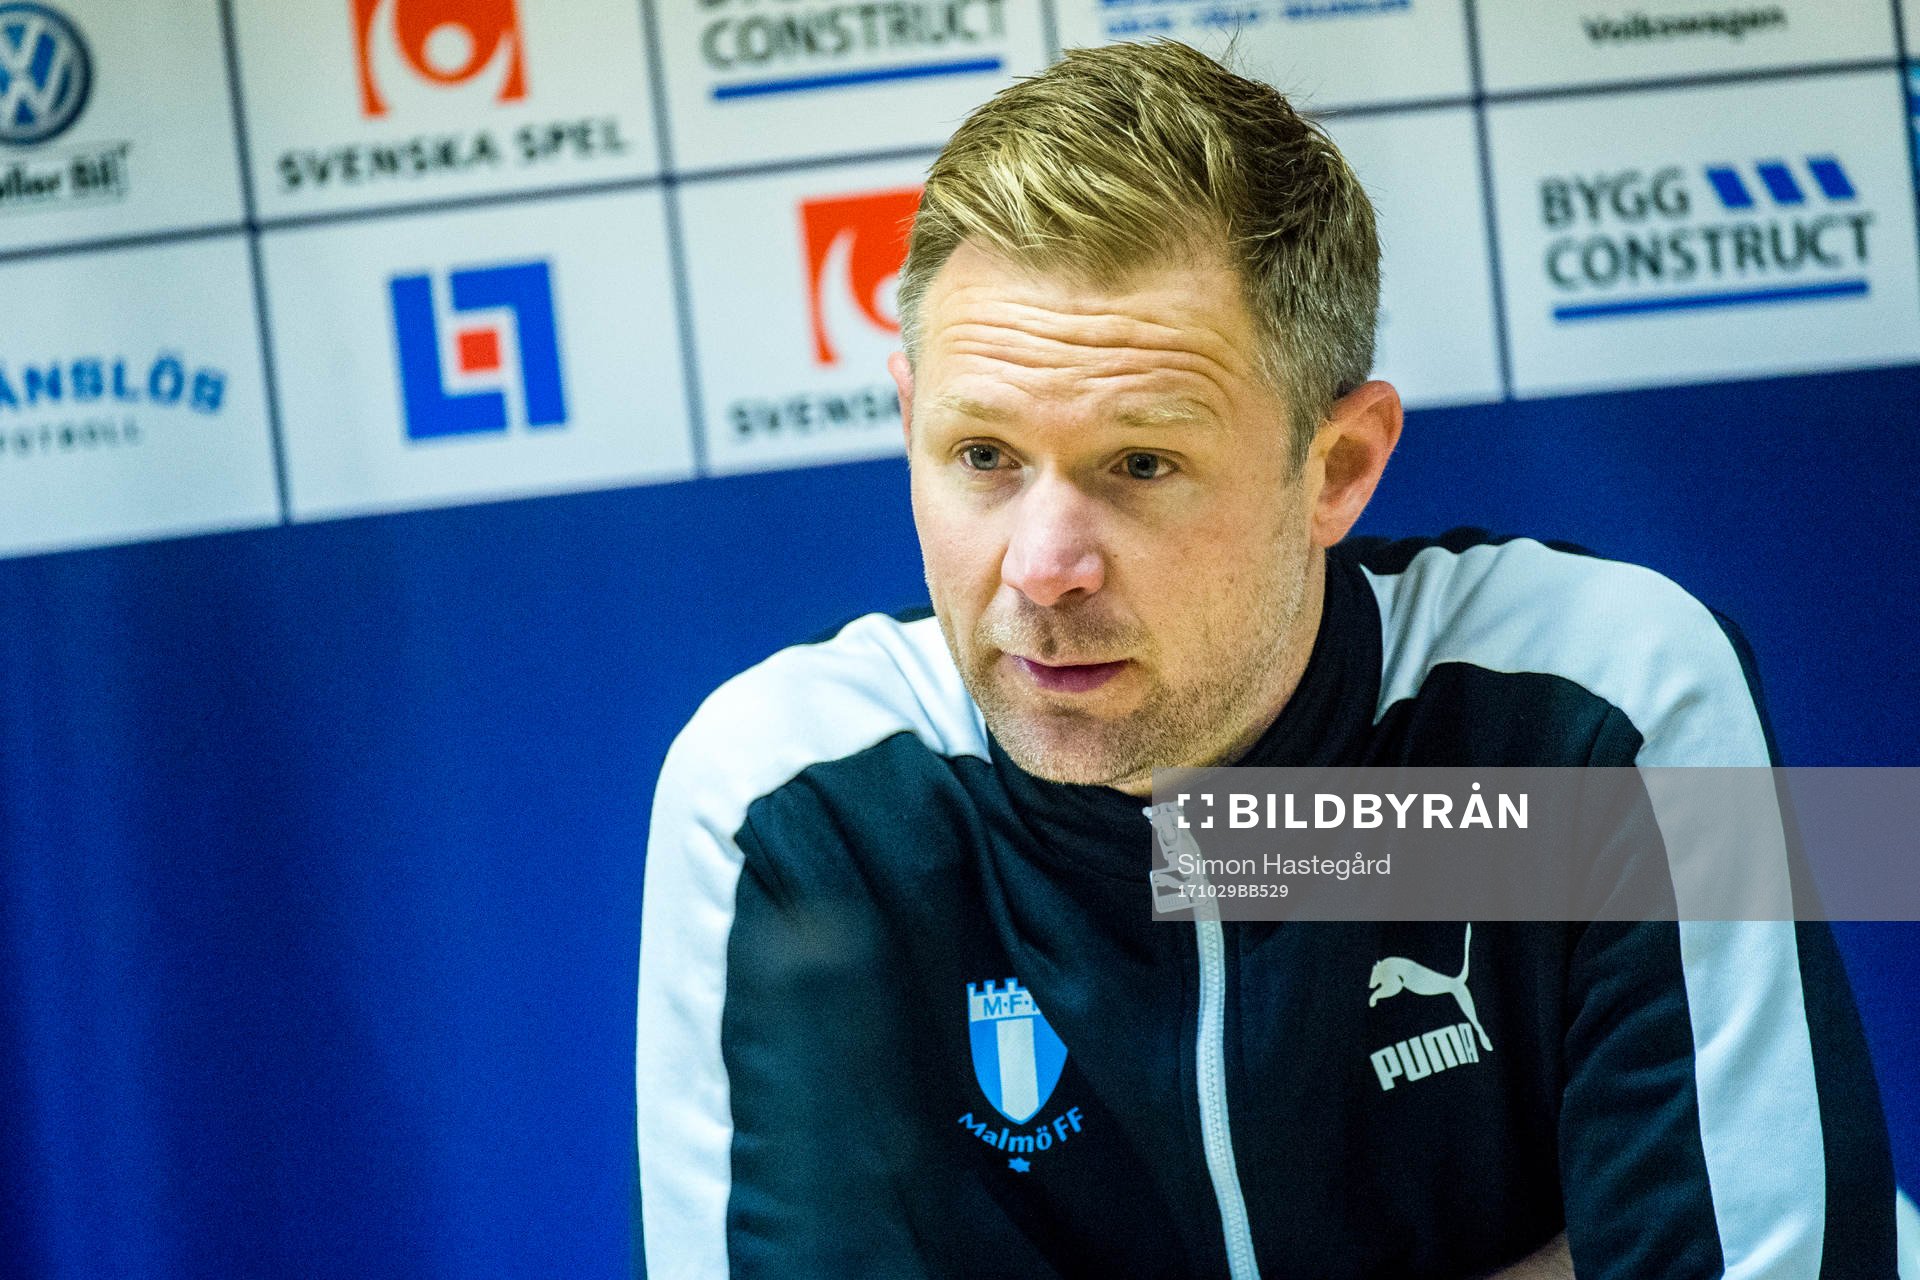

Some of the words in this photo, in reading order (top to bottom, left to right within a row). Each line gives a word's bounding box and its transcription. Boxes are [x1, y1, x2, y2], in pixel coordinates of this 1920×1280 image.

[701, 0, 1005, 71] CONSTRUCT
[1579, 4, 1787, 46] Volkswagen
[277, 130, 499, 193] SVENSKA
[514, 114, 629, 161] SPEL
[1540, 165, 1690, 231] BYGG
[1545, 211, 1874, 292] CONSTRUCT
[1369, 1022, 1480, 1092] PUMA
[957, 1111, 1054, 1153] Malmö
[1052, 1105, 1084, 1143] FF
